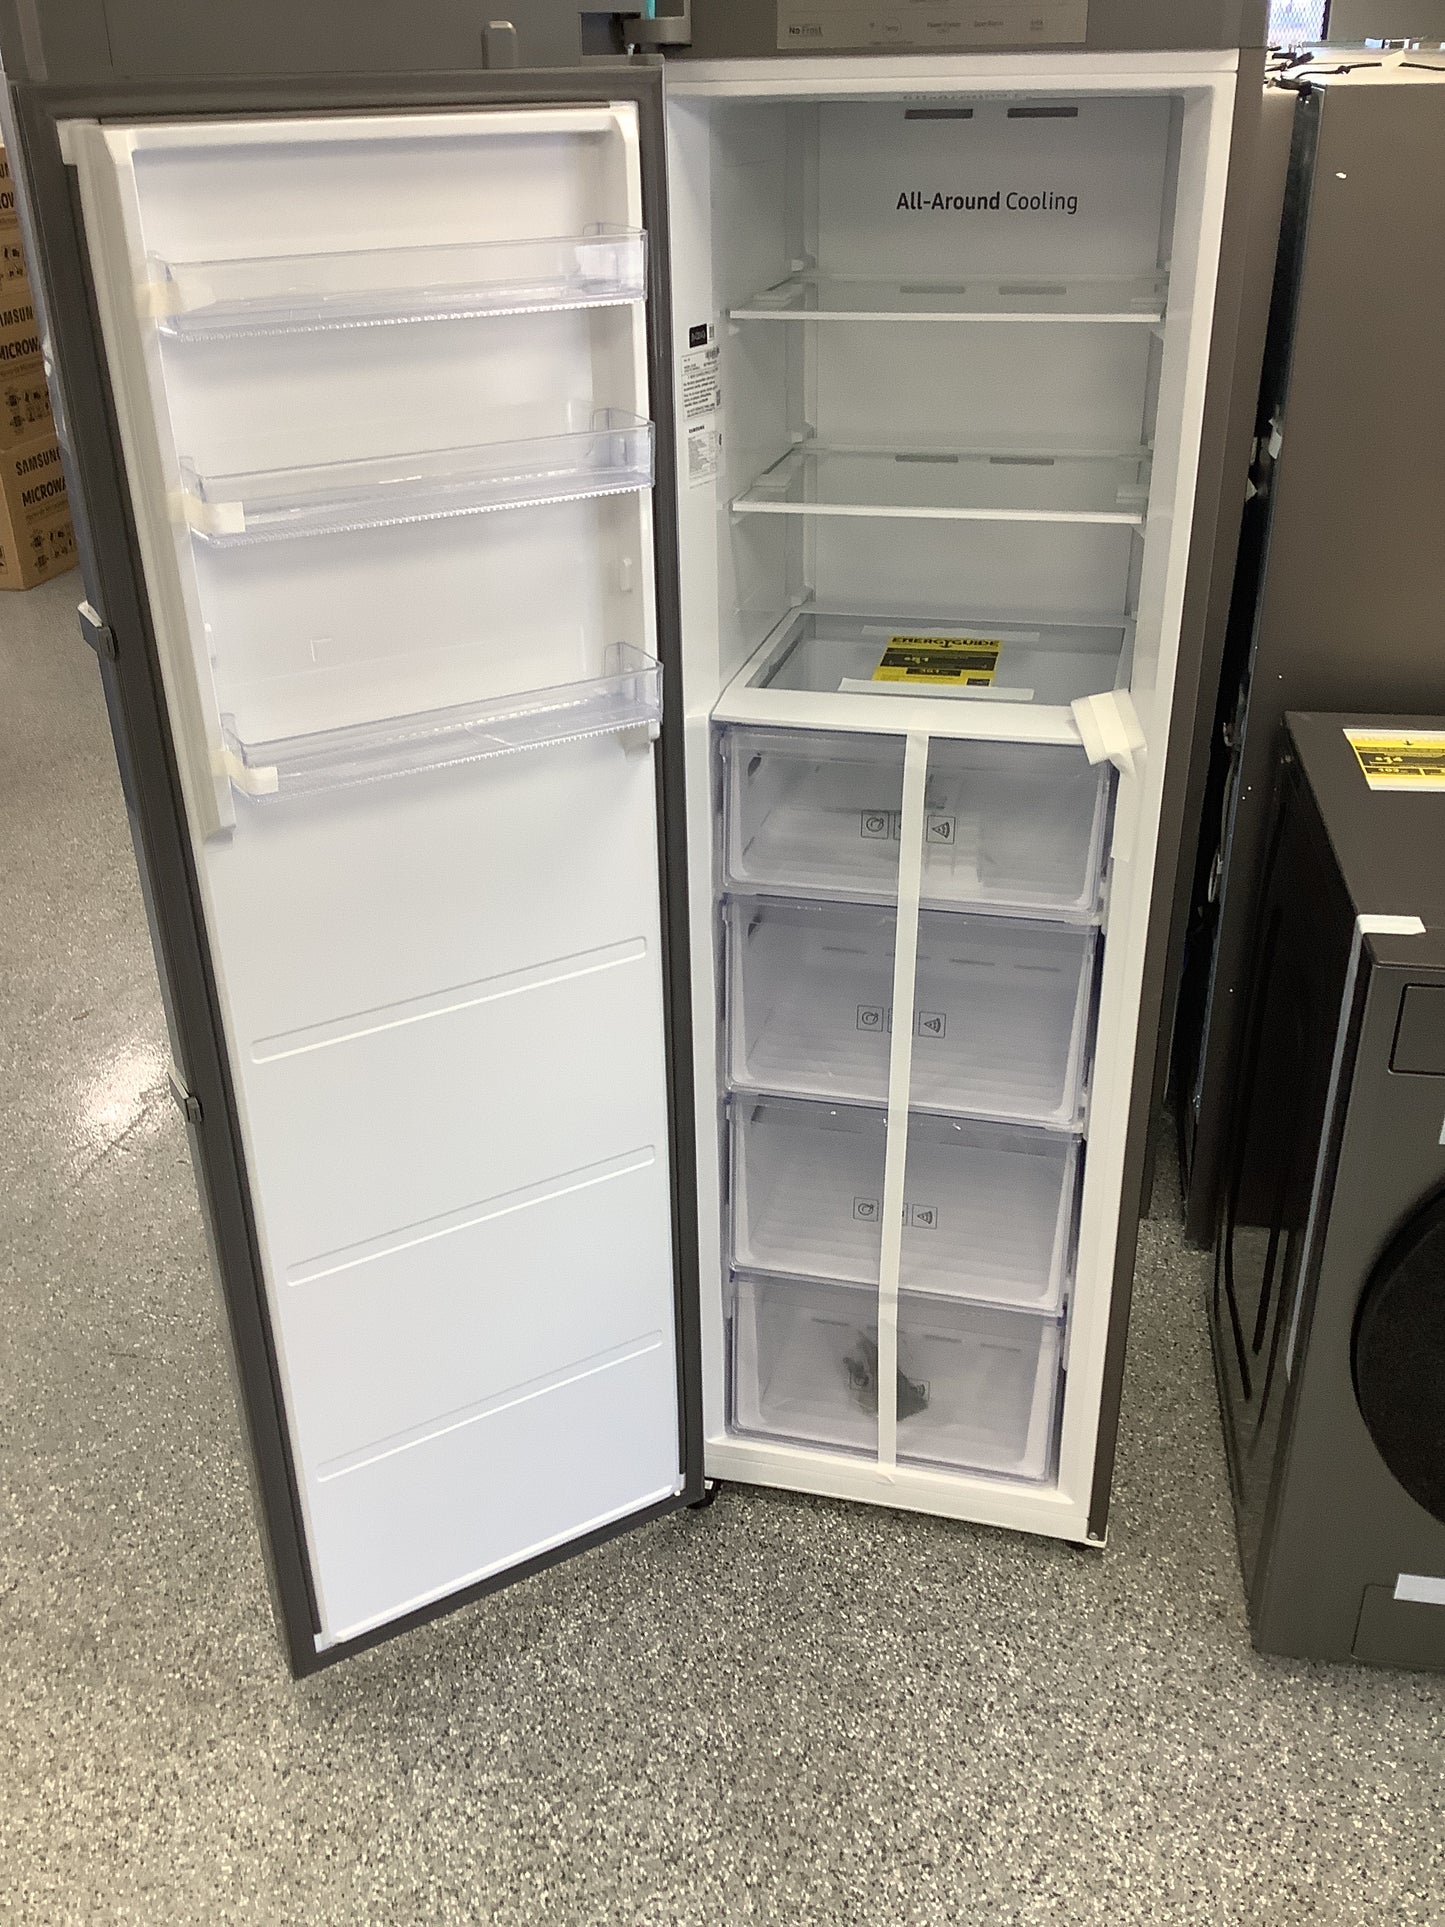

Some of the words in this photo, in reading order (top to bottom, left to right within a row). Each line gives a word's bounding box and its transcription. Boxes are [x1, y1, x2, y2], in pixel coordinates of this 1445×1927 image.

[896, 191, 1000, 210] All-Around
[1006, 191, 1078, 215] Cooling
[0, 336, 40, 361] MICROW
